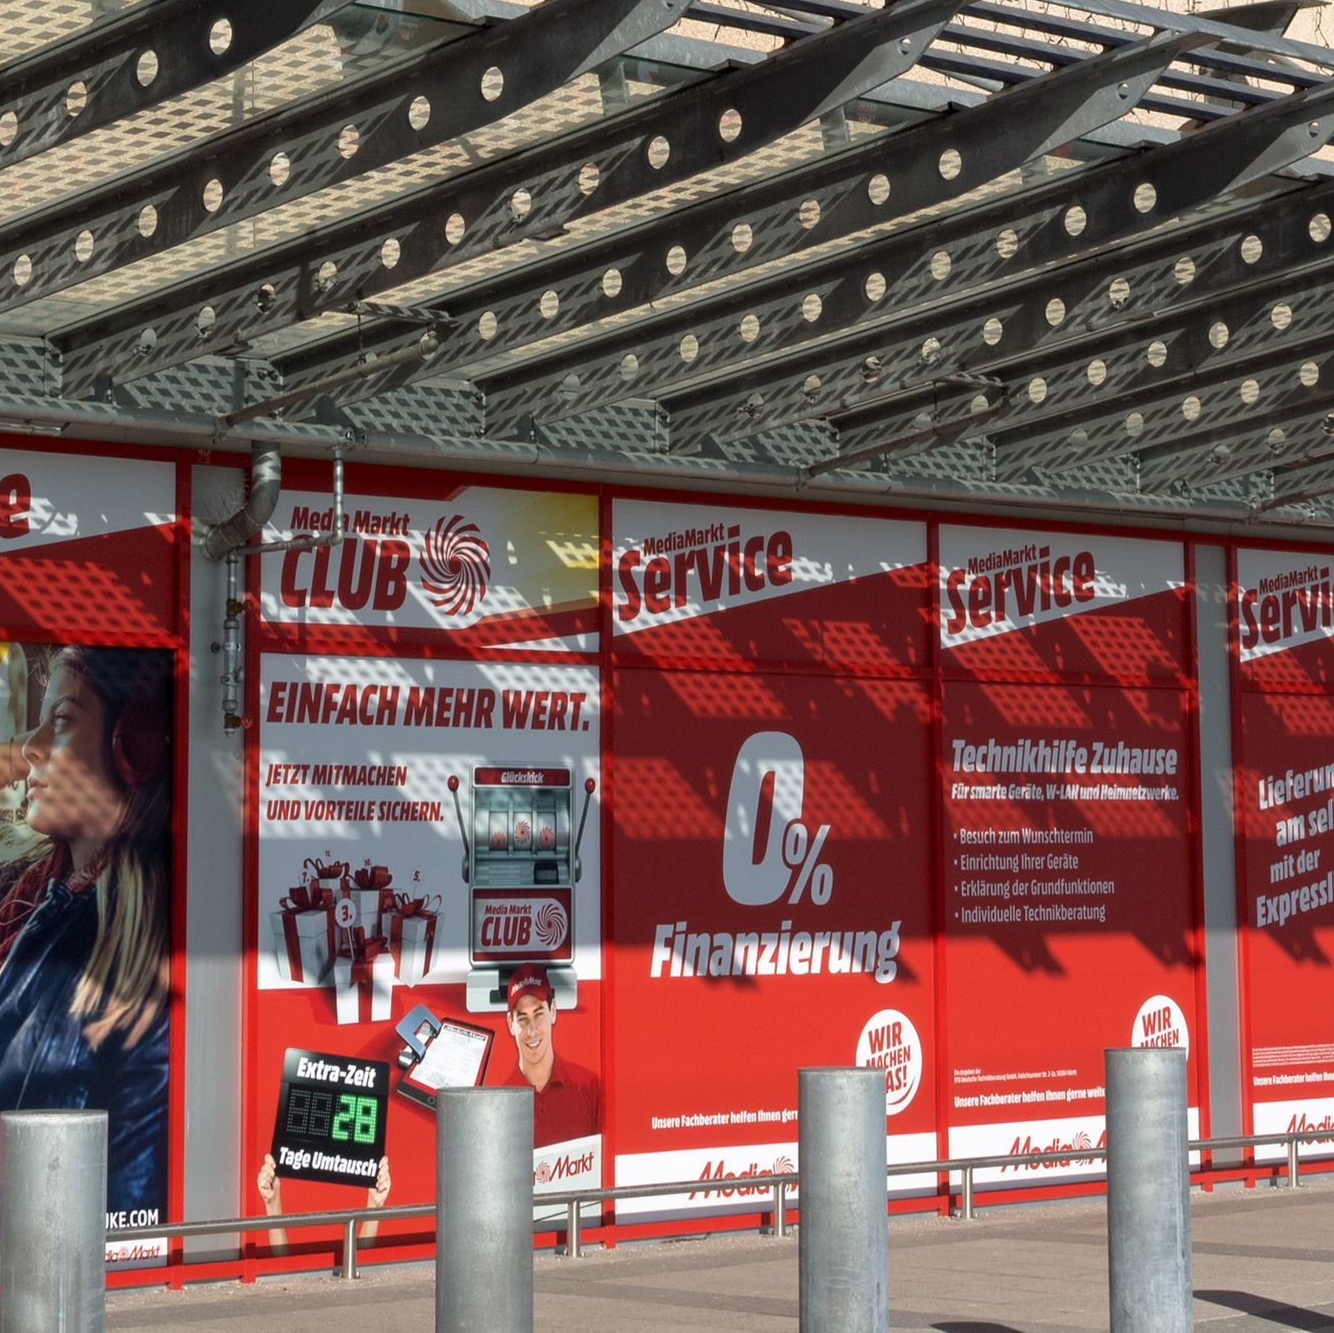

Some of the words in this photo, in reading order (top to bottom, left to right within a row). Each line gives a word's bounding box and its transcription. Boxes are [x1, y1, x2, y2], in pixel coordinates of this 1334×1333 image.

[290, 505, 349, 531] Meda
[352, 509, 411, 536] Markt
[643, 522, 725, 557] MediaMarkt
[279, 533, 412, 612] CLUB
[617, 524, 793, 622] Service
[968, 544, 1037, 576] MediaMarkt
[946, 545, 1096, 636] Service
[1259, 565, 1319, 596] MediaMarkt
[266, 681, 400, 726] EINFACH
[403, 686, 496, 729] MEHR
[501, 688, 590, 732] WERT.
[952, 738, 1088, 774] Technikhilfe
[1090, 741, 1178, 775] Zuhause
[265, 763, 311, 788] JETZT
[311, 764, 408, 787] MITMACHEN
[970, 784, 1007, 800] smarte
[1008, 783, 1045, 802] Geräte,
[1100, 784, 1179, 801] Heimnetzwerke.
[265, 799, 302, 821] UND
[304, 799, 376, 822] VORTEILE
[377, 800, 445, 823] SICHERN.
[960, 828, 996, 845] Besuch
[998, 830, 1020, 845] zum
[1021, 828, 1094, 844] Wunschtermin
[1275, 814, 1305, 847] am
[960, 853, 1019, 873] Einrichtung
[1047, 853, 1079, 870] Geräte
[1270, 853, 1295, 884] mit
[1296, 849, 1321, 875] der
[961, 879, 1010, 900] Erklärung
[1030, 878, 1115, 895] Grundfunktionen
[961, 905, 1021, 923] Individuelle
[1023, 904, 1106, 923] Technikberatung
[480, 916, 532, 947] CLUB
[650, 919, 902, 985] Finanzierung
[1141, 1005, 1172, 1037] WIR
[867, 1021, 903, 1054] WIR
[296, 1057, 377, 1088] Extra-Zeit
[979, 1093, 1022, 1106] Fachberater
[332, 1094, 378, 1144] 28
[651, 1115, 681, 1130] Unsere
[681, 1112, 730, 1128] Fachberater
[730, 1110, 757, 1125] helfen
[278, 1146, 311, 1171] Tage
[312, 1150, 378, 1178] Umtausch
[548, 1151, 595, 1187] Markt
[105, 1208, 159, 1229] KE.COM
